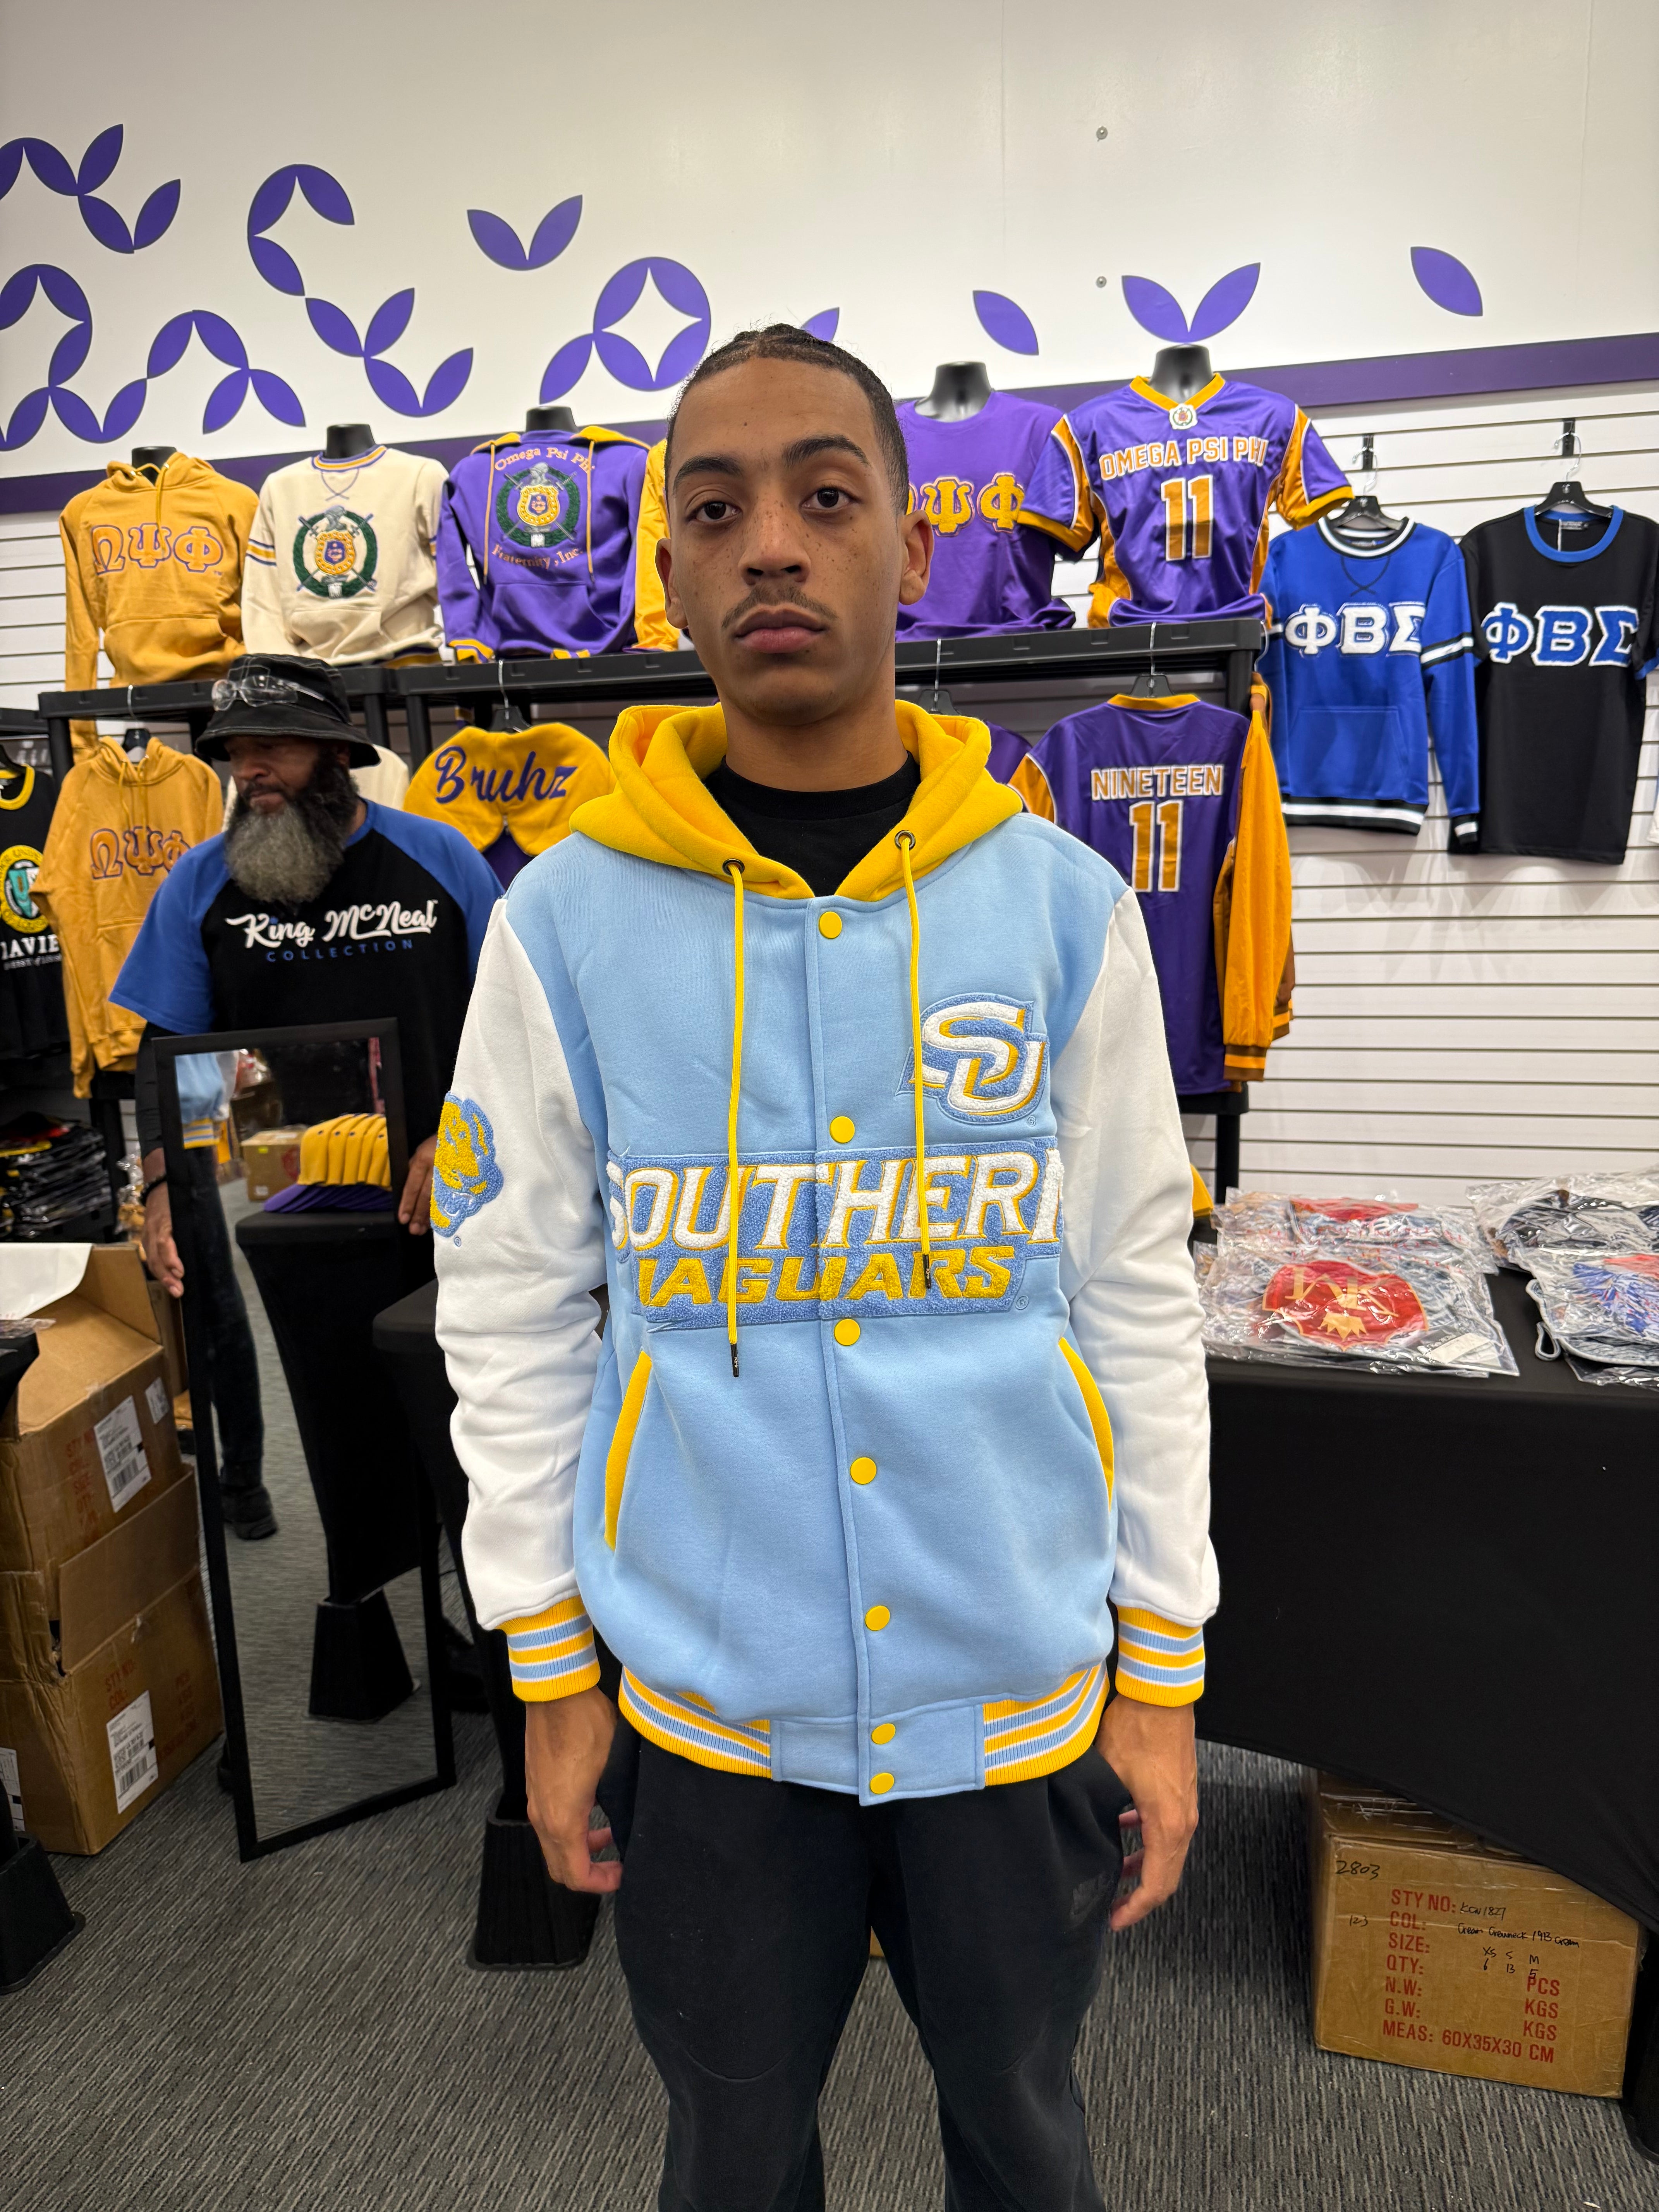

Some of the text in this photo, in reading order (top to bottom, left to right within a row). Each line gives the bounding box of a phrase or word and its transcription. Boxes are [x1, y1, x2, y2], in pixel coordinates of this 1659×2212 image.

[495, 448, 541, 471] Omega
[546, 447, 569, 460] Psi
[1099, 436, 1269, 481] OMEGA PSI PHI
[1161, 474, 1213, 561] 11
[91, 522, 223, 575] ΩΨΦ
[491, 543, 550, 570] Fraternity
[1284, 601, 1425, 658] ΦΒΣ
[1480, 602, 1639, 667] ΦΒΣ
[434, 745, 579, 804] Bruhz
[1091, 764, 1224, 800] NINETEEN
[1129, 799, 1183, 893] 11
[225, 901, 438, 948] King McNeal
[266, 939, 413, 962] COLLECTION
[908, 1001, 1046, 1116] SU
[1335, 1860, 1380, 1880] 2803
[1391, 1889, 1456, 1913] STY NO:
[1389, 1910, 1426, 1930] COL:
[1388, 1932, 1430, 1953] SIZE:
[1387, 1954, 1424, 1974] QTY:
[1530, 1954, 1539, 1965] M
[1385, 1976, 1422, 1997] N.W:
[1527, 1976, 1560, 1996] PCS
[1385, 1998, 1420, 2018] G.W:
[1525, 1998, 1558, 2019] KGS
[1383, 2019, 1554, 2063] MEAS: 60X35X30 CM
[1523, 2020, 1557, 2041] KGS
